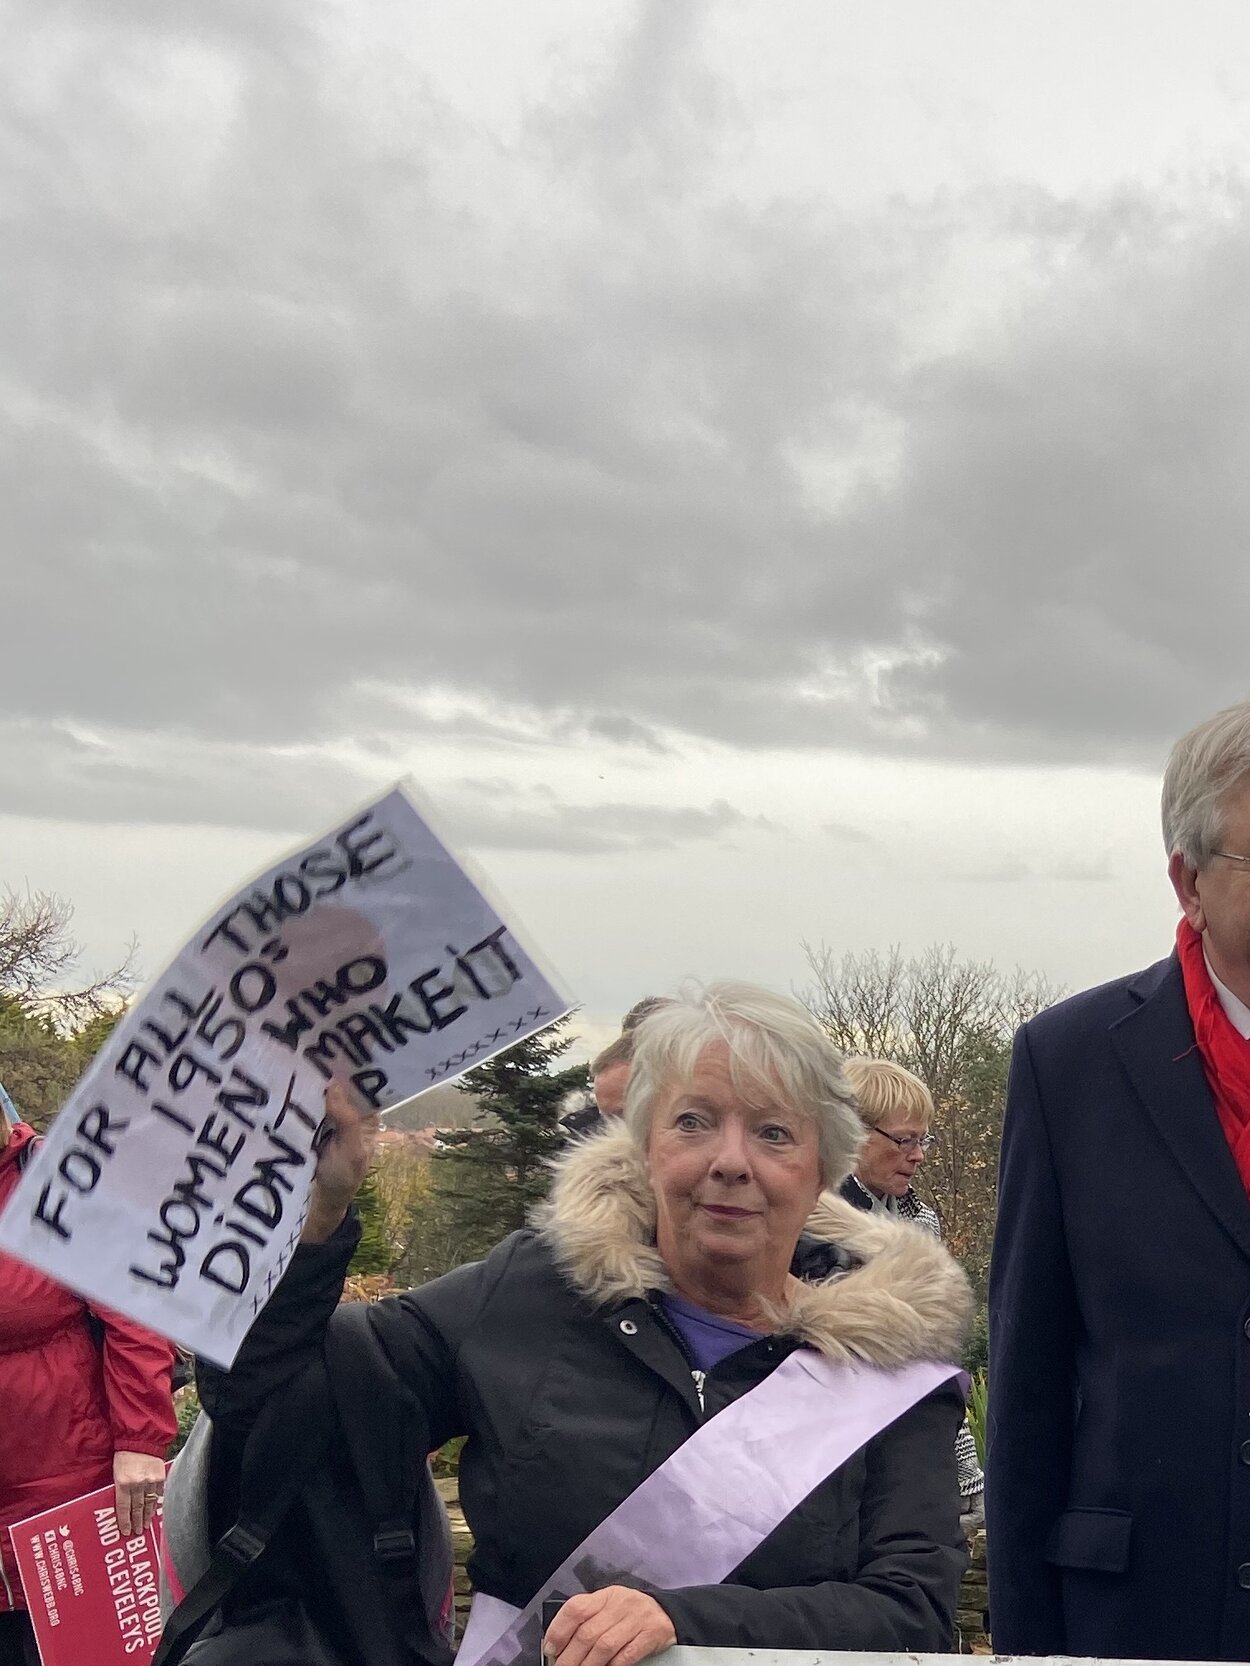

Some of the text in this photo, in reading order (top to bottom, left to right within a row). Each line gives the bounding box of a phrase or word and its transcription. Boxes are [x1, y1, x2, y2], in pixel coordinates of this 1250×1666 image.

[31, 811, 400, 1242] FOR ALL THOSE
[303, 966, 468, 1081] MAKE
[128, 953, 389, 1289] WOMEN WHO
[94, 1507, 144, 1654] AND CLEVELEYS
[125, 1534, 162, 1645] BLACKPOOL
